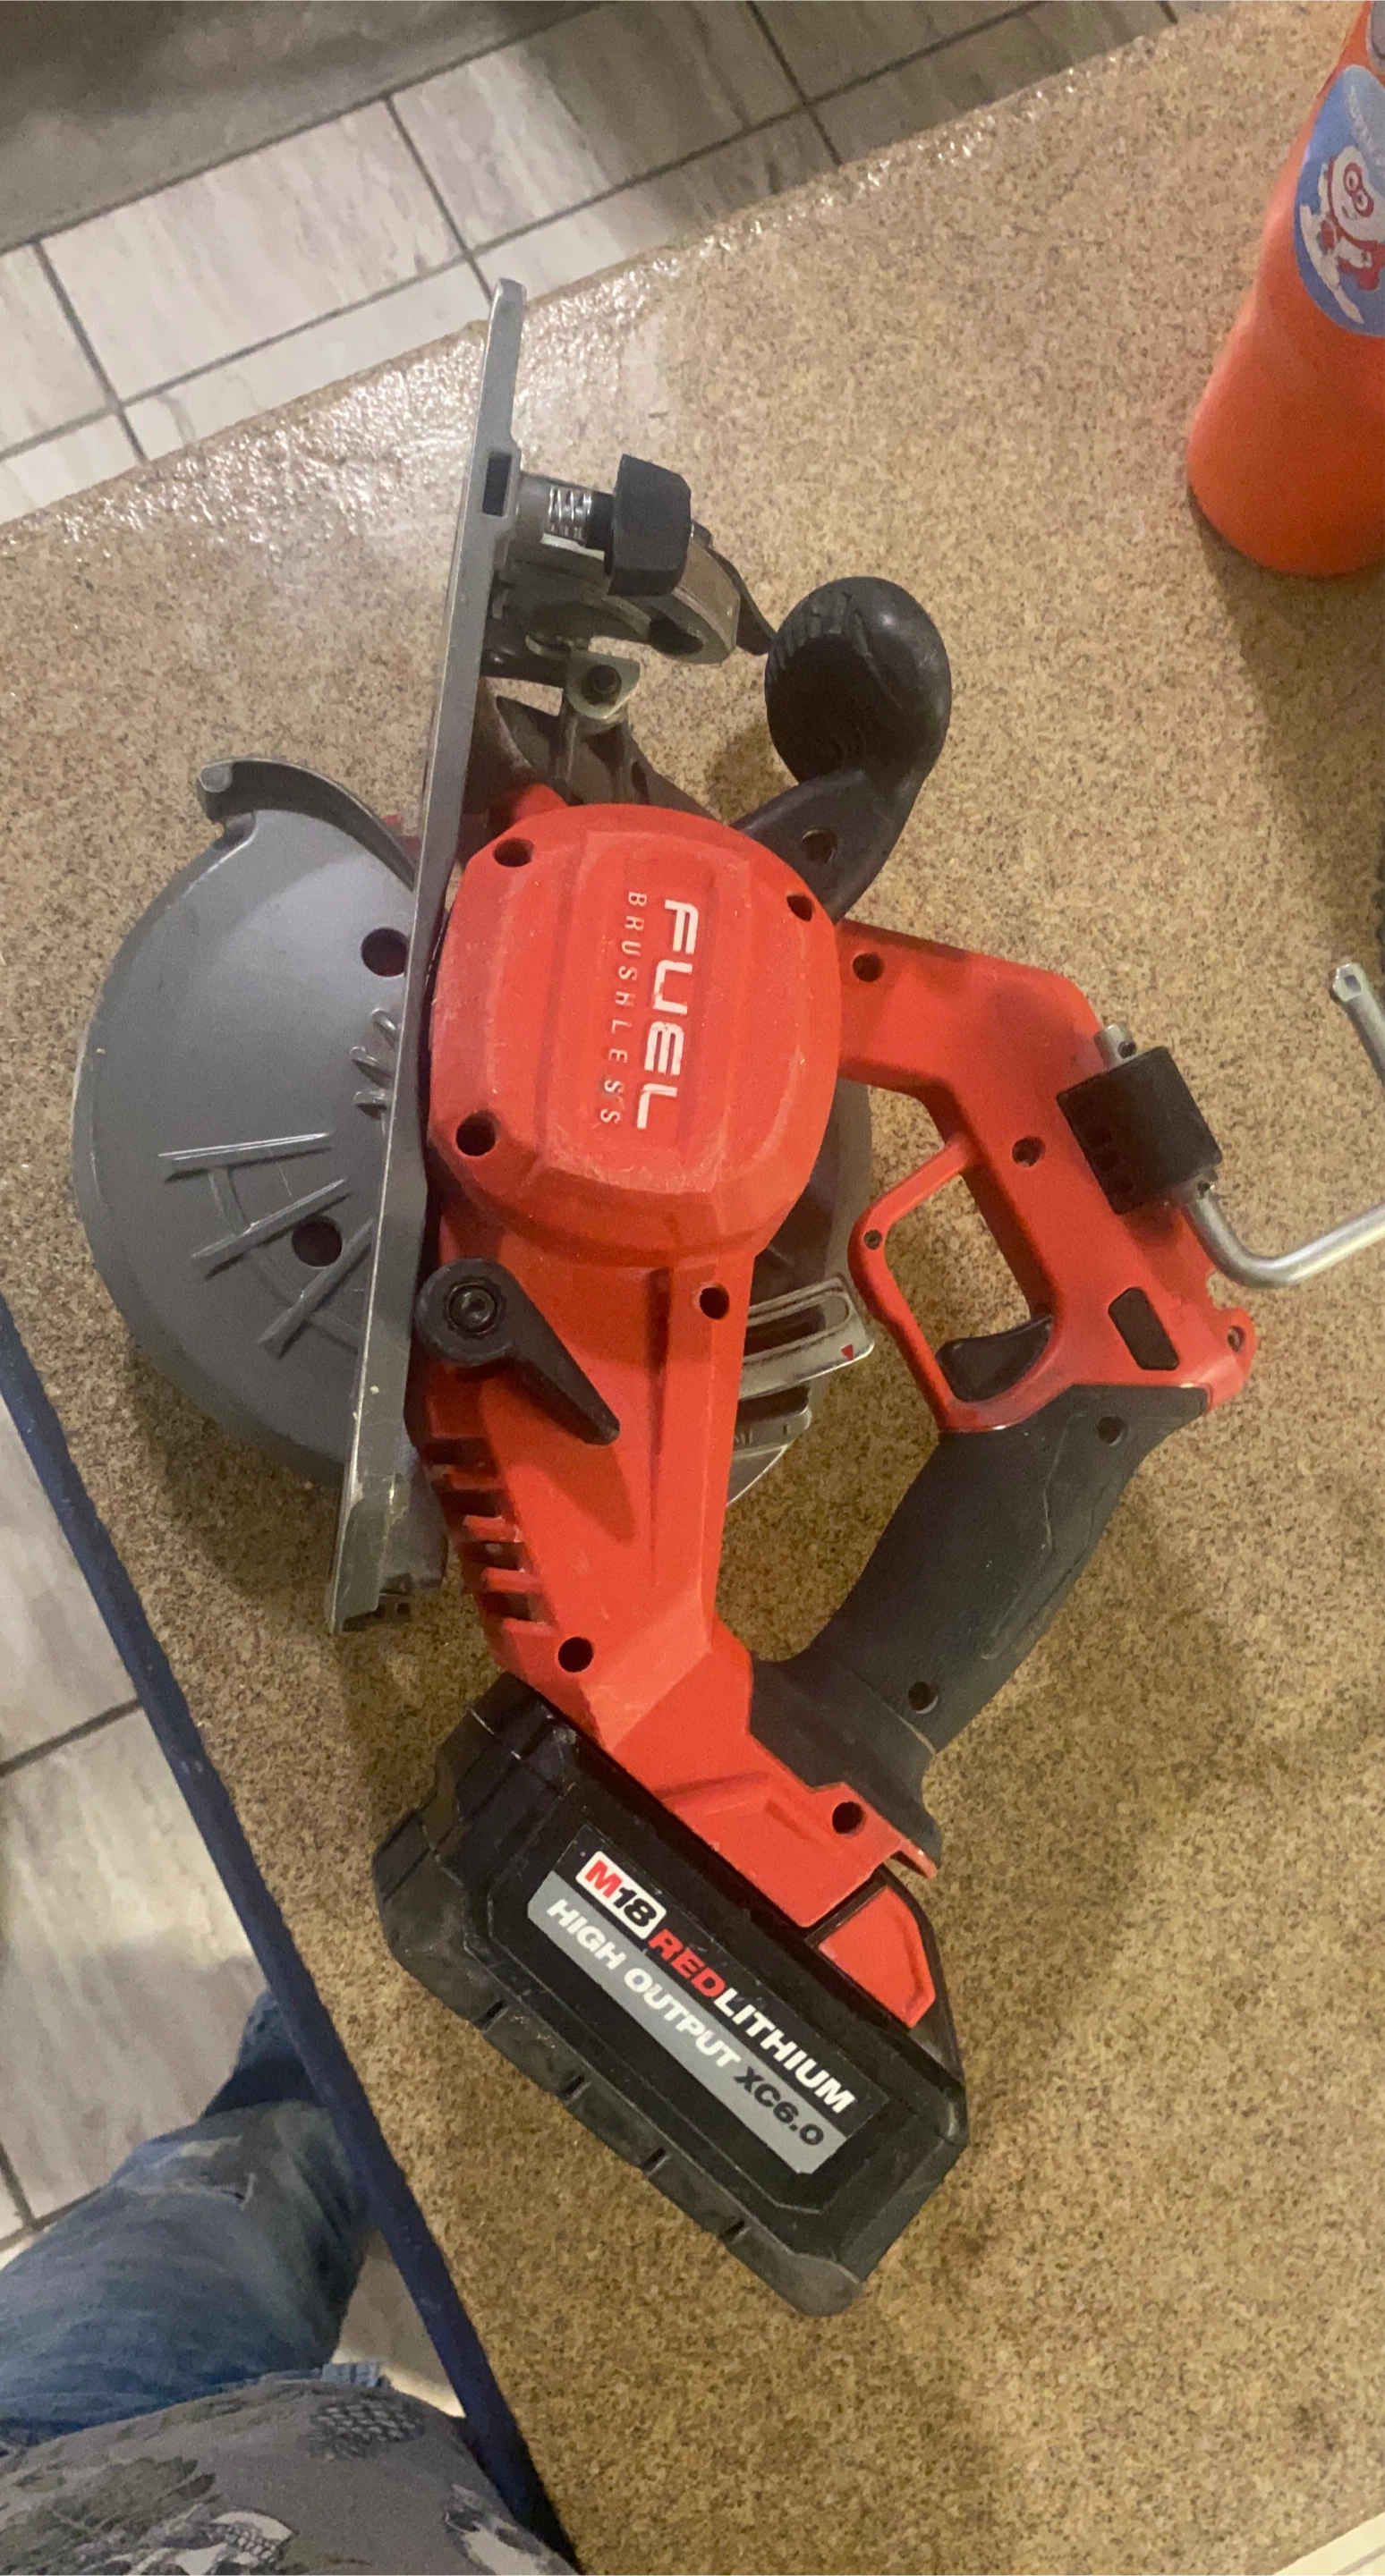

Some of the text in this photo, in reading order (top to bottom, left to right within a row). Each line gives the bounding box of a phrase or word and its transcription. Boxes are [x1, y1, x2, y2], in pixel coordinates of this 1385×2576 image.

[600, 892, 647, 1124] BRUSHLESS
[637, 899, 699, 1130] FUEL
[547, 1899, 824, 2147] HIGH OUTPUT XC6.0
[584, 1860, 856, 2114] M18 REDLITHIUM
